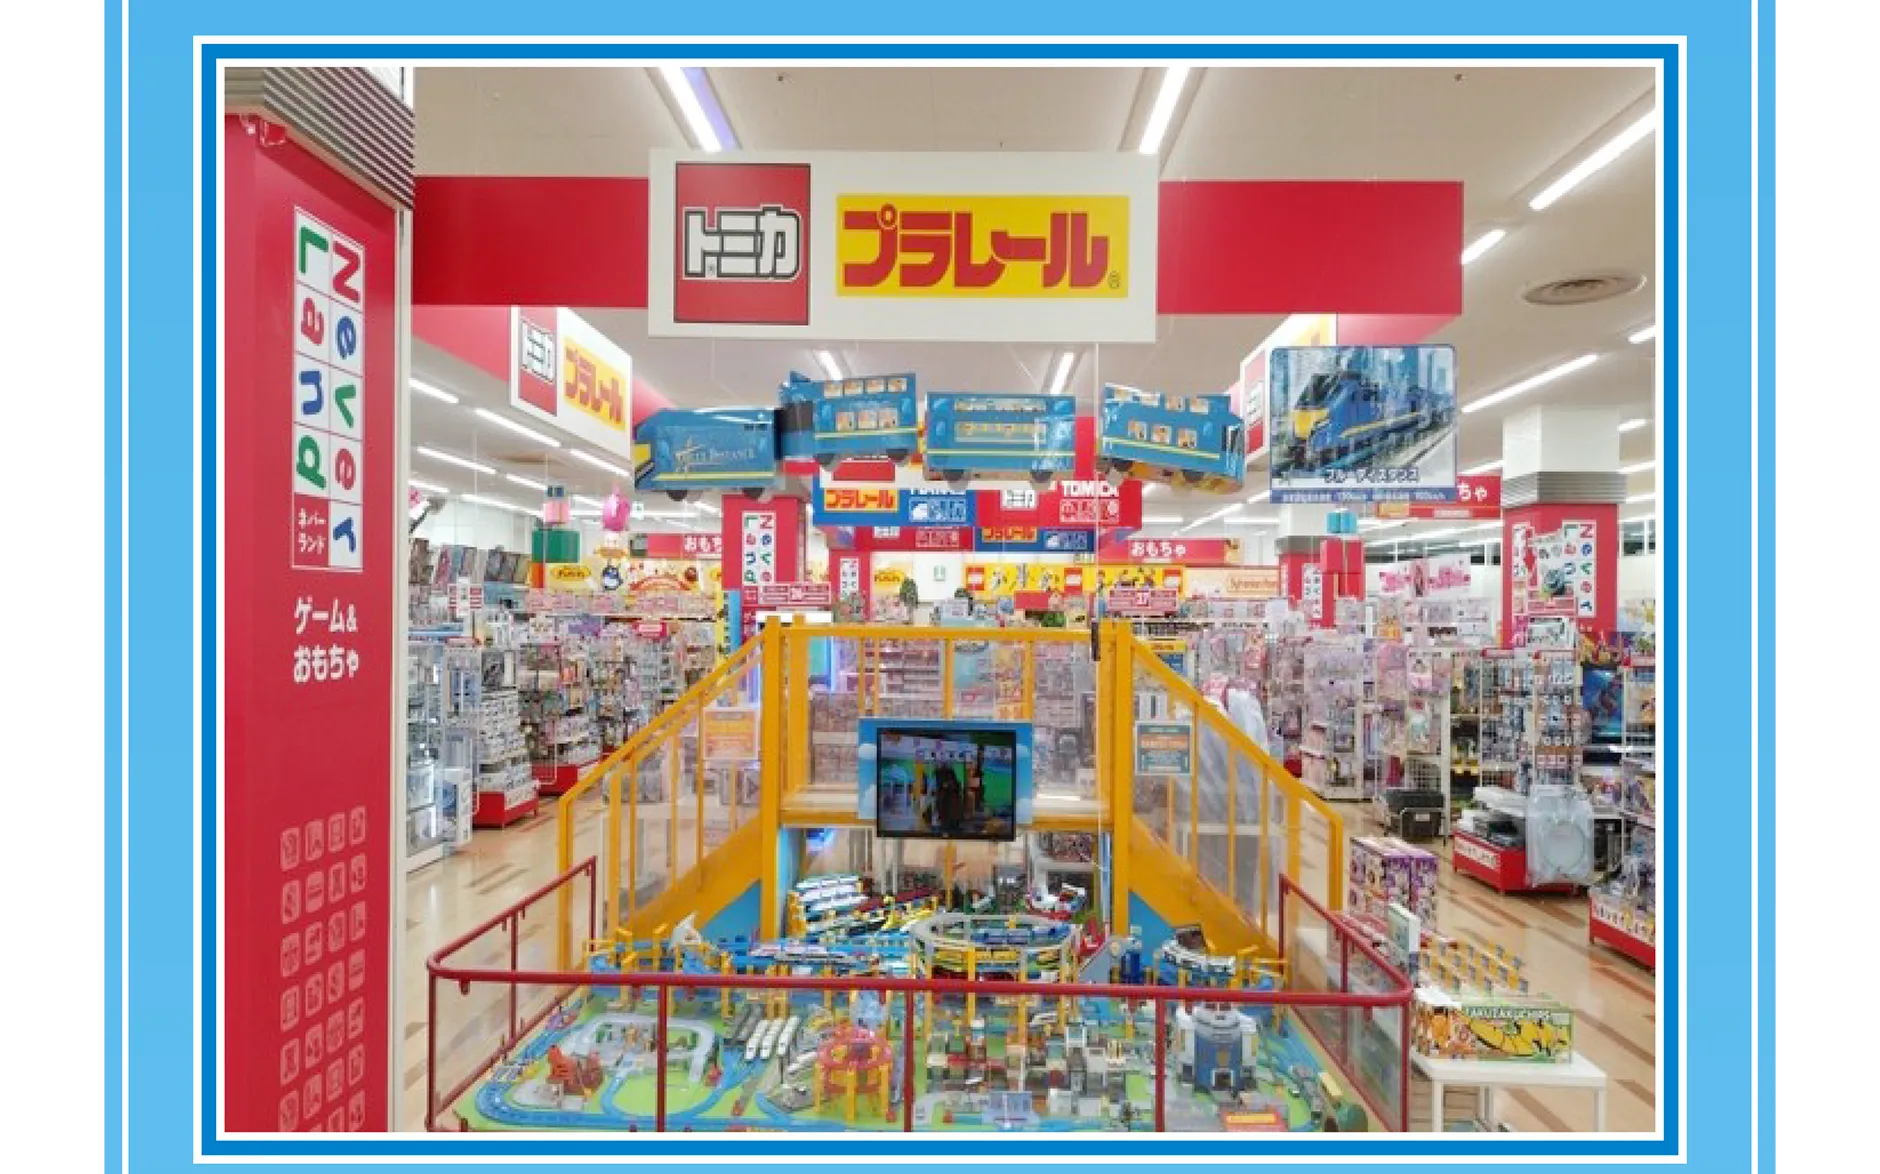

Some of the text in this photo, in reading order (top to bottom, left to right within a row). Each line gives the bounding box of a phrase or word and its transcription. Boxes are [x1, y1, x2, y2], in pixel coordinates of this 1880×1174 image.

[683, 203, 803, 281] トミカ
[842, 203, 1110, 289] プラレール
[520, 319, 555, 384] トミカ
[564, 347, 623, 424] プラレール
[1130, 541, 1186, 557] おもちゃ
[293, 644, 359, 683] おもちゃ
